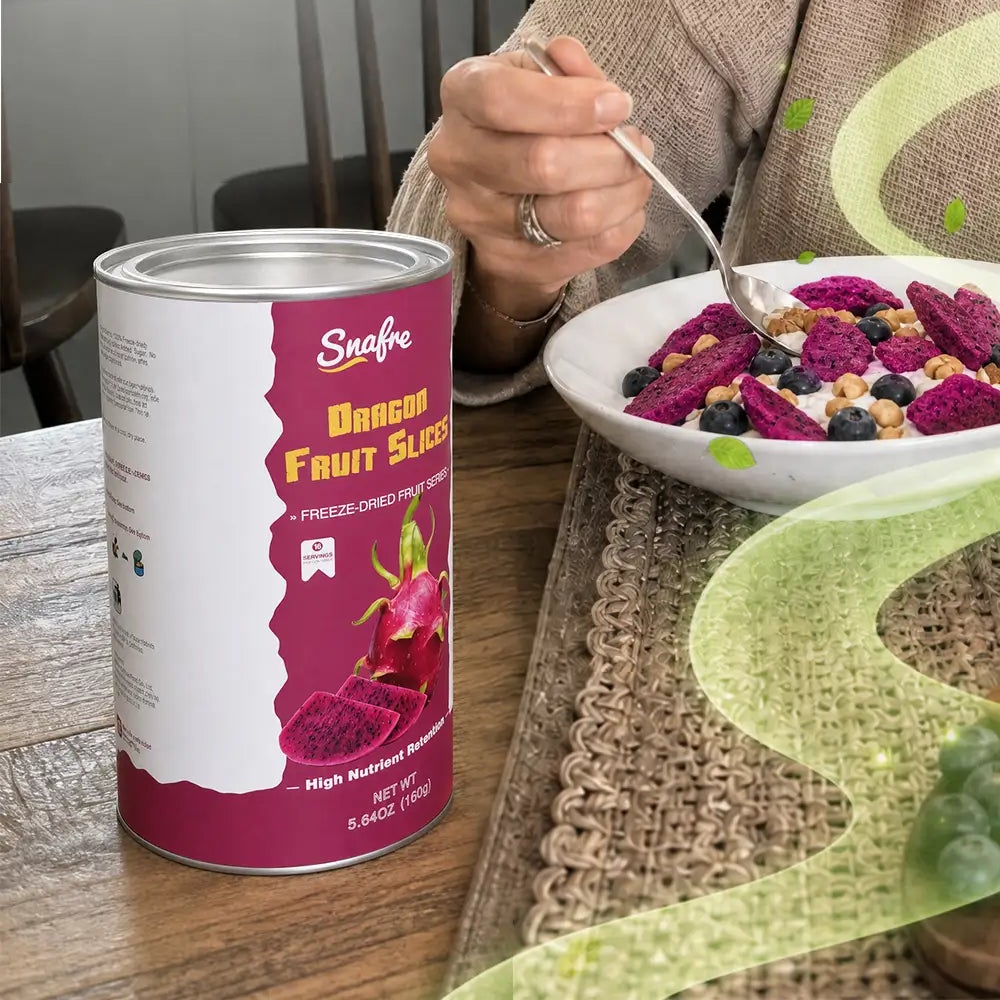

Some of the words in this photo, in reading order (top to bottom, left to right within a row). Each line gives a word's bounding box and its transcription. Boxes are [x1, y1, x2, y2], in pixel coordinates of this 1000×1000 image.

[316, 315, 412, 367] Snafre
[284, 447, 378, 484] FRUIT
[388, 415, 449, 465] SLICES
[301, 493, 396, 522] FREEZE-DRIED
[398, 481, 426, 502] FRUIT
[303, 552, 333, 561] SERVINGS
[305, 774, 343, 791] High
[348, 750, 405, 782] Nutrient
[407, 717, 445, 757] Retention
[347, 803, 396, 831] 5.64OZ
[400, 778, 432, 811] (160g)
[373, 783, 398, 804] NET
[400, 771, 417, 792] WT
